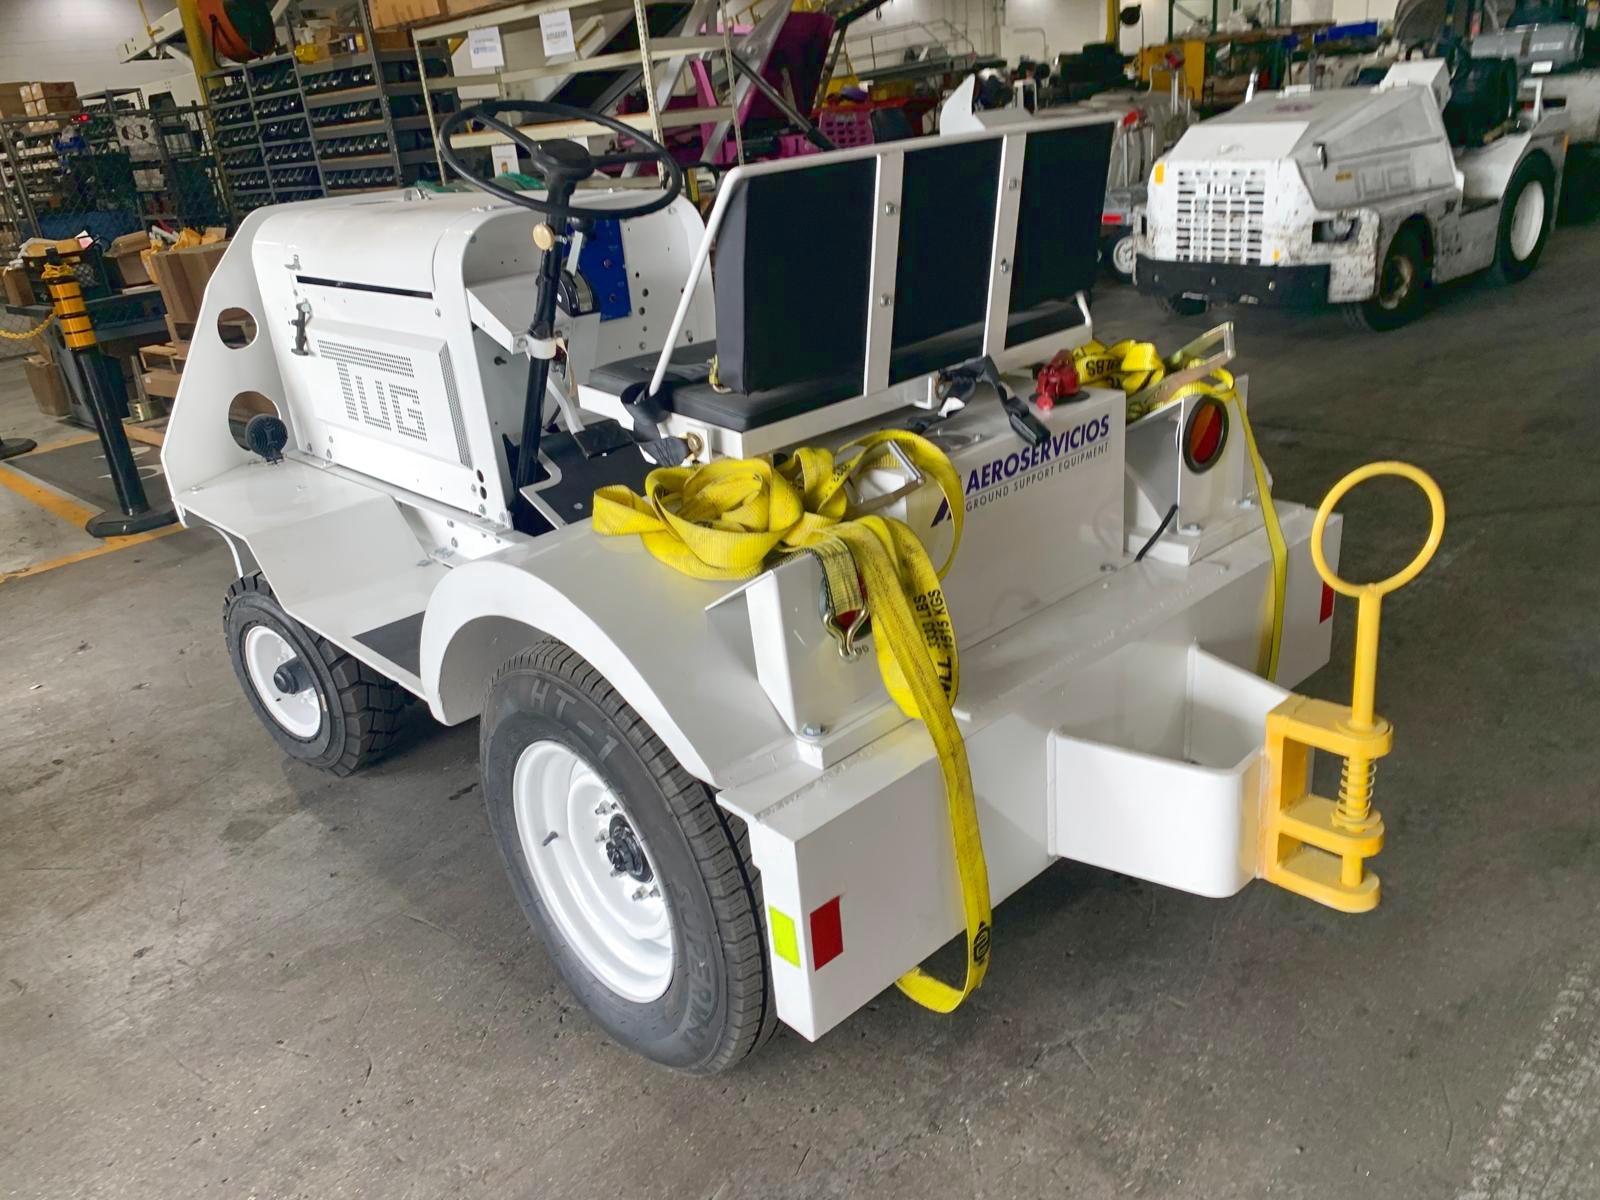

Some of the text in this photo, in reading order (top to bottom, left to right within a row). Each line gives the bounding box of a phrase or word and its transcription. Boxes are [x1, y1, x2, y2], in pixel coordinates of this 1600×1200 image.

[317, 339, 427, 442] TUG
[965, 414, 1110, 495] AEROSERVICIOS
[965, 487, 1009, 512] GROUND
[1013, 468, 1055, 492] SUPPORT
[1058, 443, 1110, 472] EQUIPMENT
[913, 594, 932, 618] LBS
[928, 589, 946, 616] KGS
